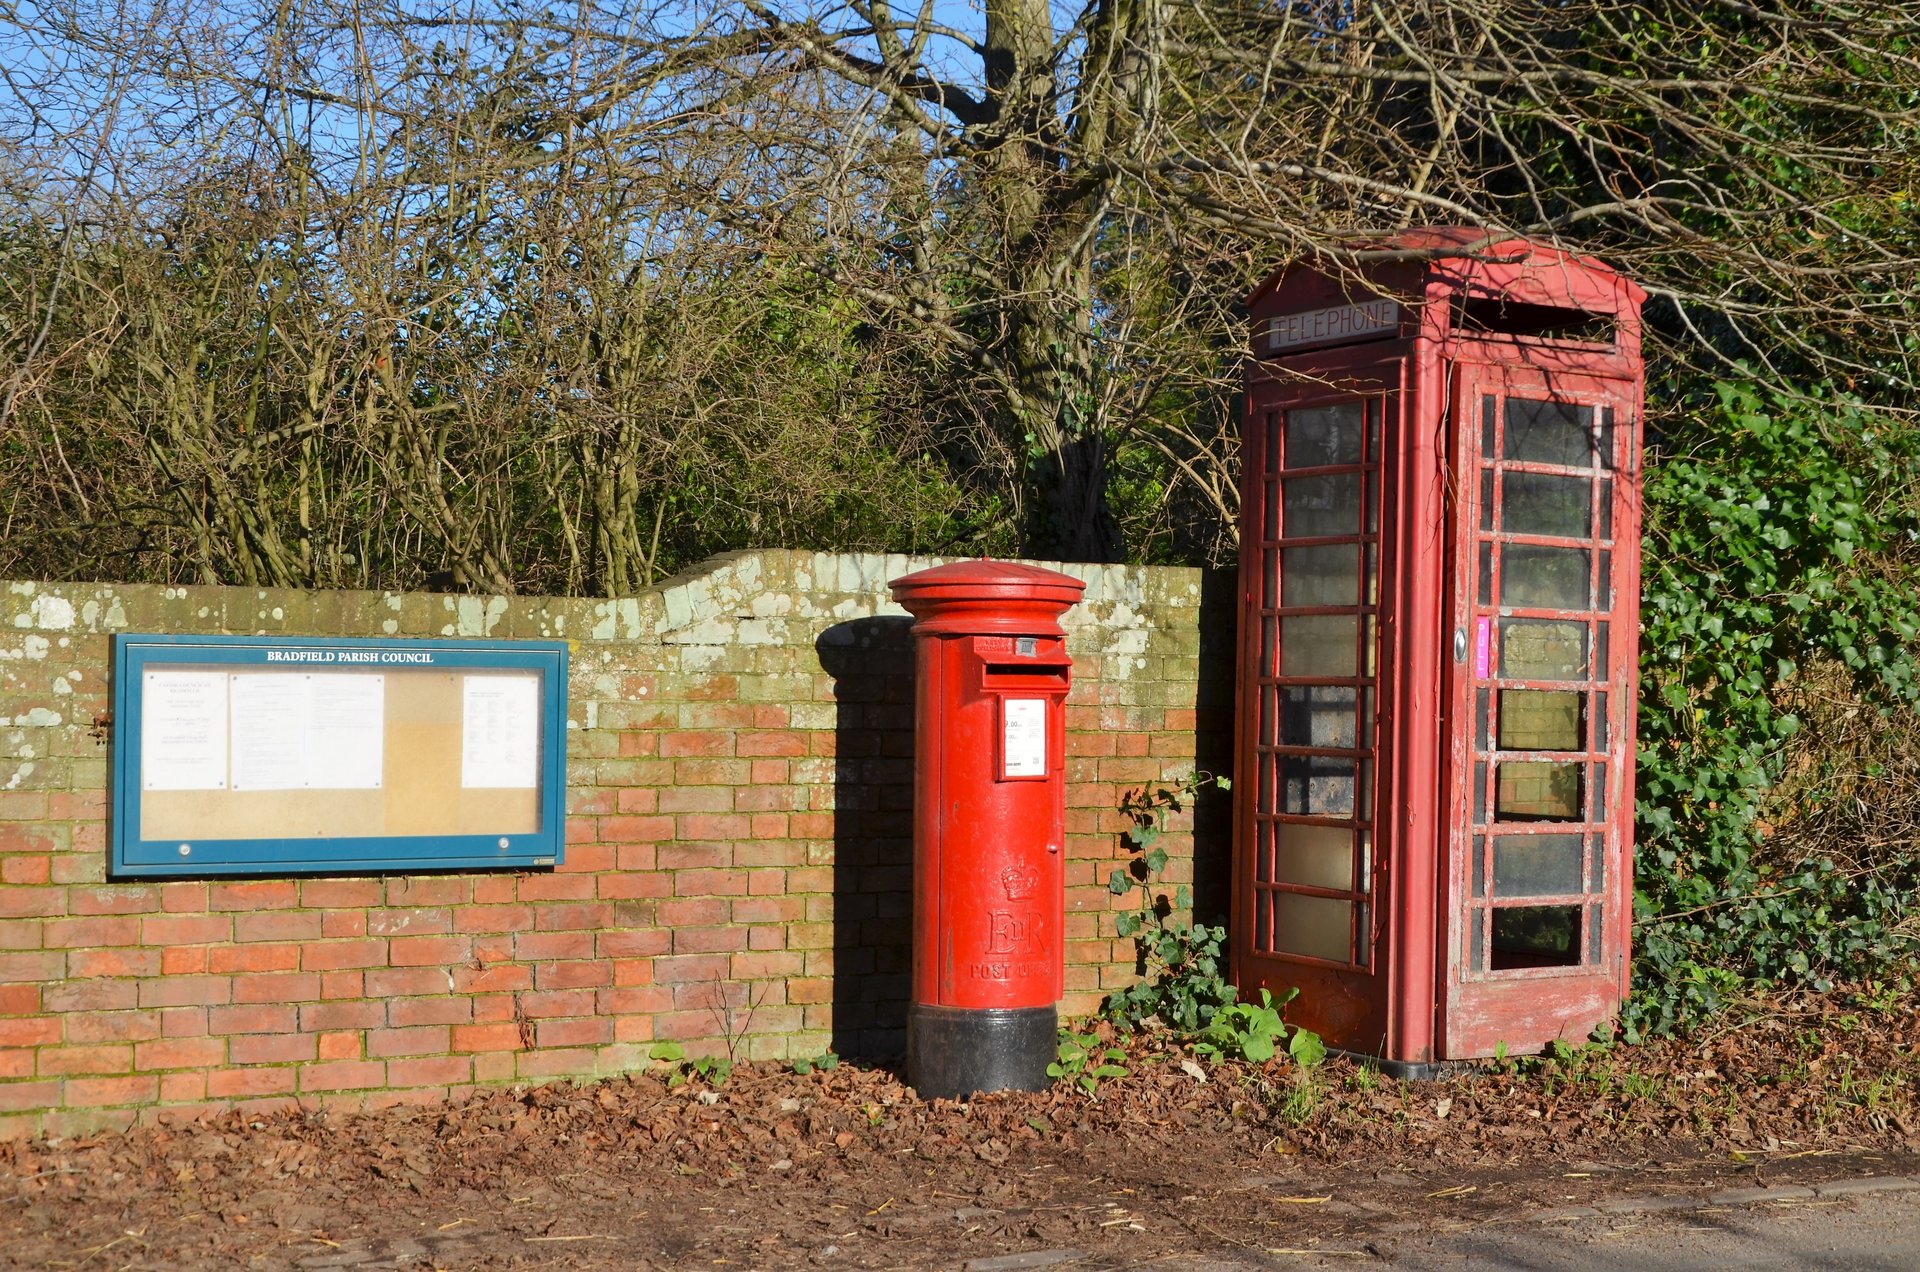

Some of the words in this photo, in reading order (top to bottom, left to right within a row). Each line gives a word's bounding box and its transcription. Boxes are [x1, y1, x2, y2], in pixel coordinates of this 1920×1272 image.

[1273, 301, 1394, 345] TELEPHONE
[267, 651, 335, 663] BRADFIELD
[338, 652, 379, 663] PARISH
[381, 653, 434, 663] COUNCIL
[970, 963, 1011, 979] POST
